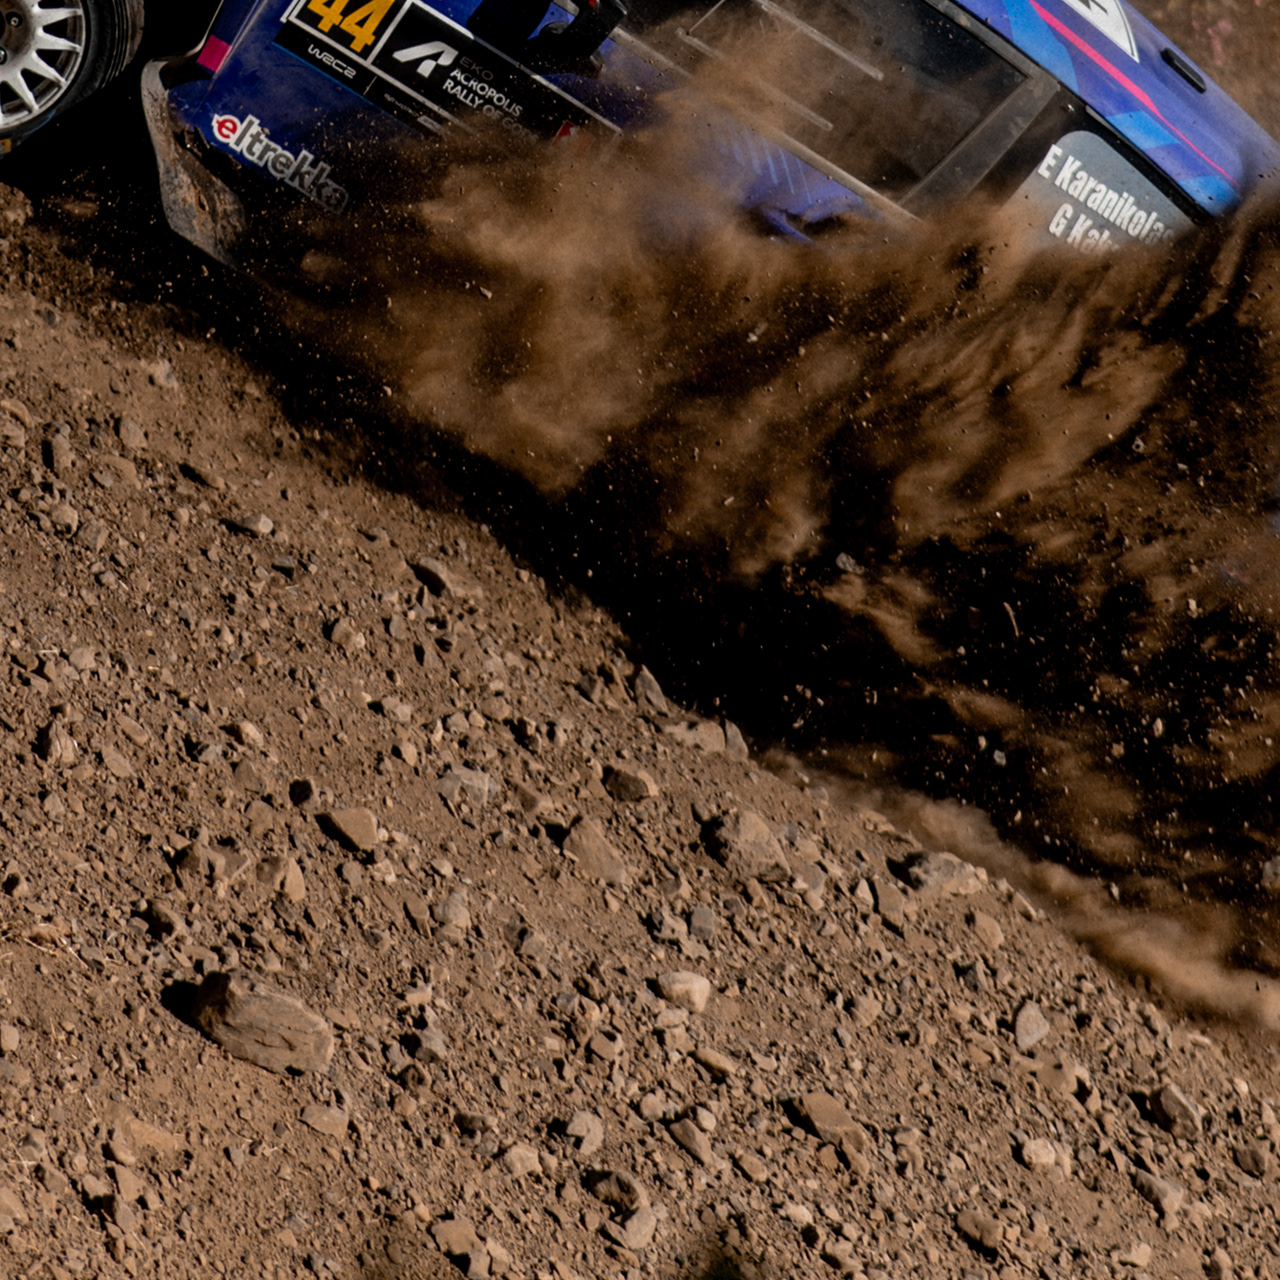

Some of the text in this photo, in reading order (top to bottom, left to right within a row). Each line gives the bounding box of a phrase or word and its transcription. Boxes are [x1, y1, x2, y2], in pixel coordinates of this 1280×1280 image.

[308, 44, 357, 80] WRC2
[460, 56, 494, 81] EKO
[442, 79, 484, 108] RALLY
[482, 104, 503, 120] OF
[450, 67, 523, 117] ACROPOLIS
[213, 113, 350, 214] eltrekka
[1037, 144, 1061, 179] E
[1047, 203, 1073, 236] G
